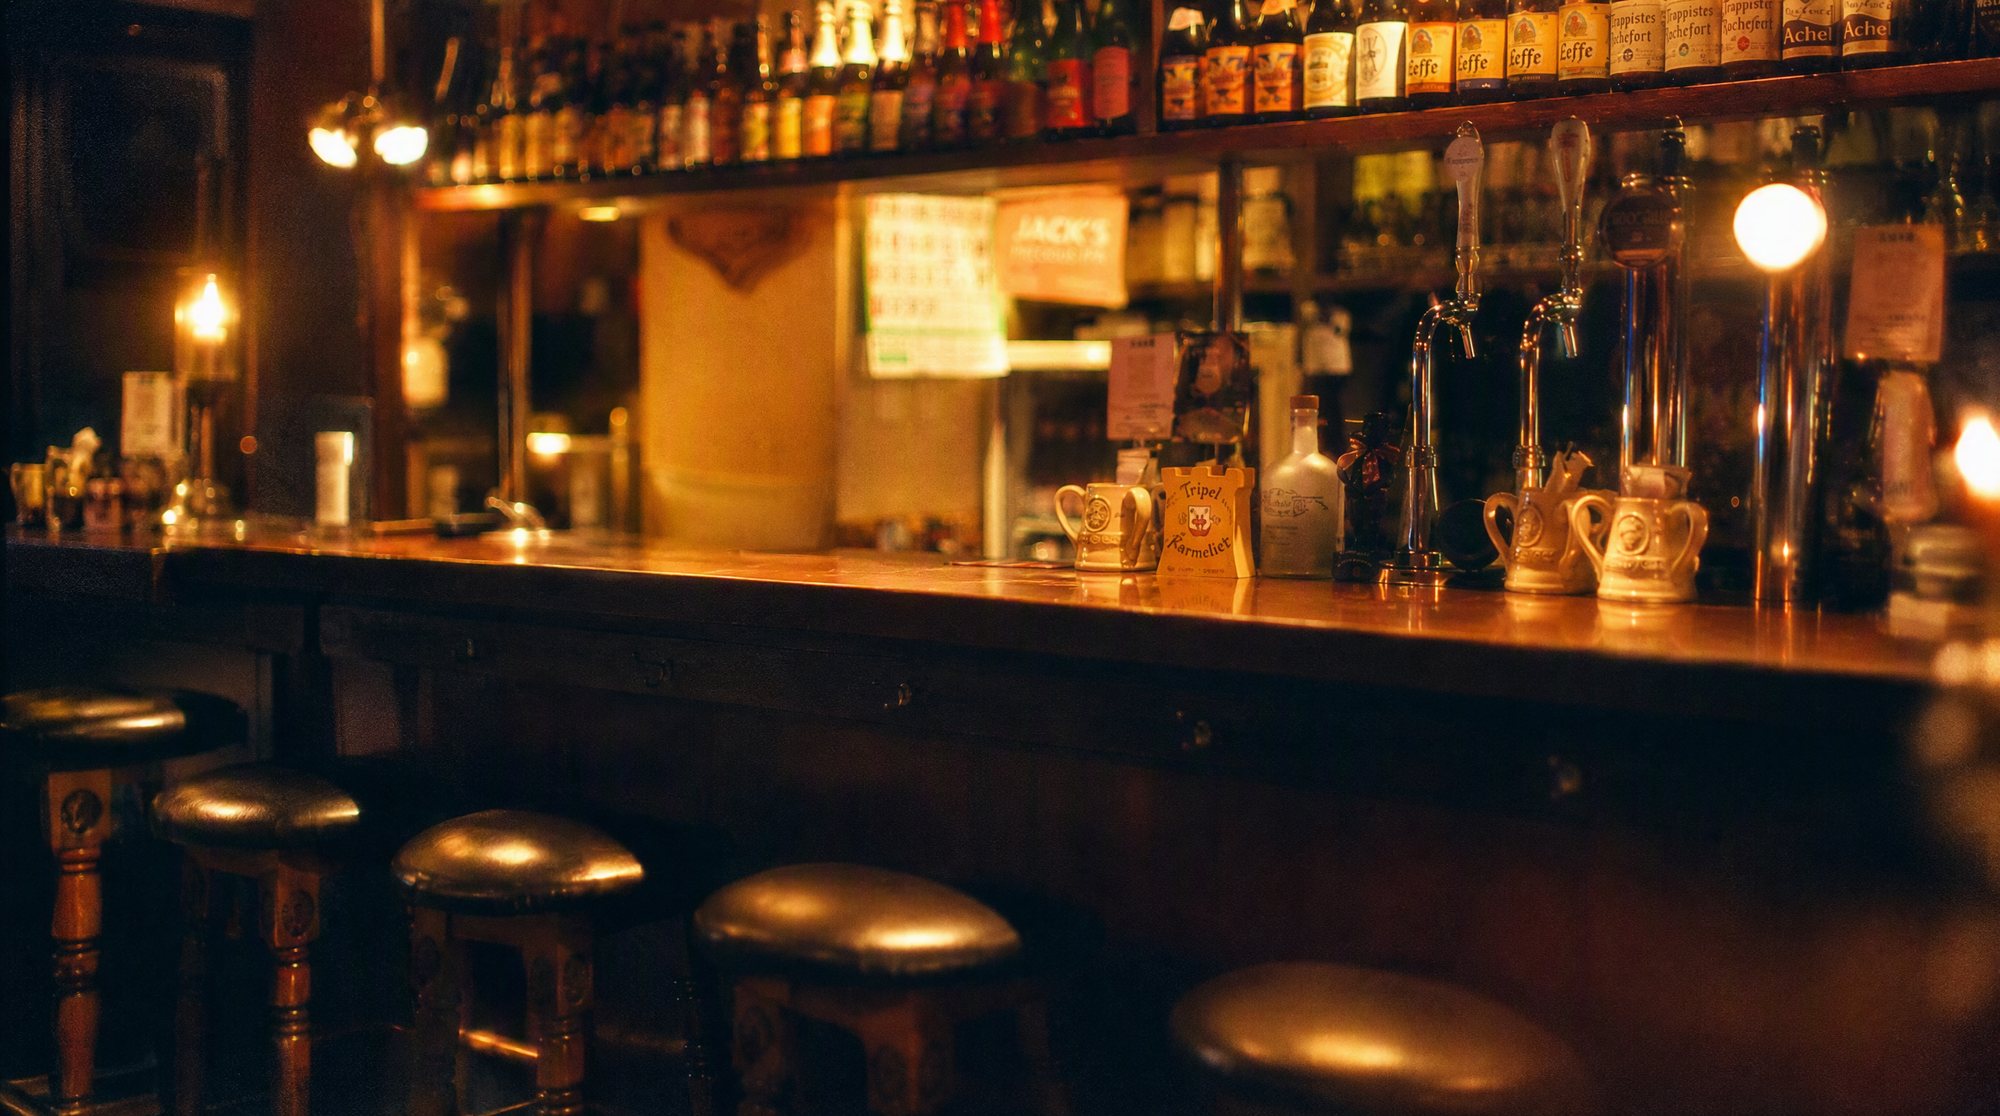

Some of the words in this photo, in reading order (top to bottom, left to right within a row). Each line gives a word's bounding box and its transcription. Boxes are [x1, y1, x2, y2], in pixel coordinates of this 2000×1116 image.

[1666, 5, 1714, 23] Trappistes
[1784, 26, 1832, 45] Achel
[1844, 20, 1891, 40] Achel
[1509, 47, 1541, 68] Leffe
[1560, 41, 1593, 63] Leffe
[1012, 214, 1110, 247] JACK'S
[1180, 481, 1222, 499] Tripel
[1167, 533, 1231, 559] Karmeliet
